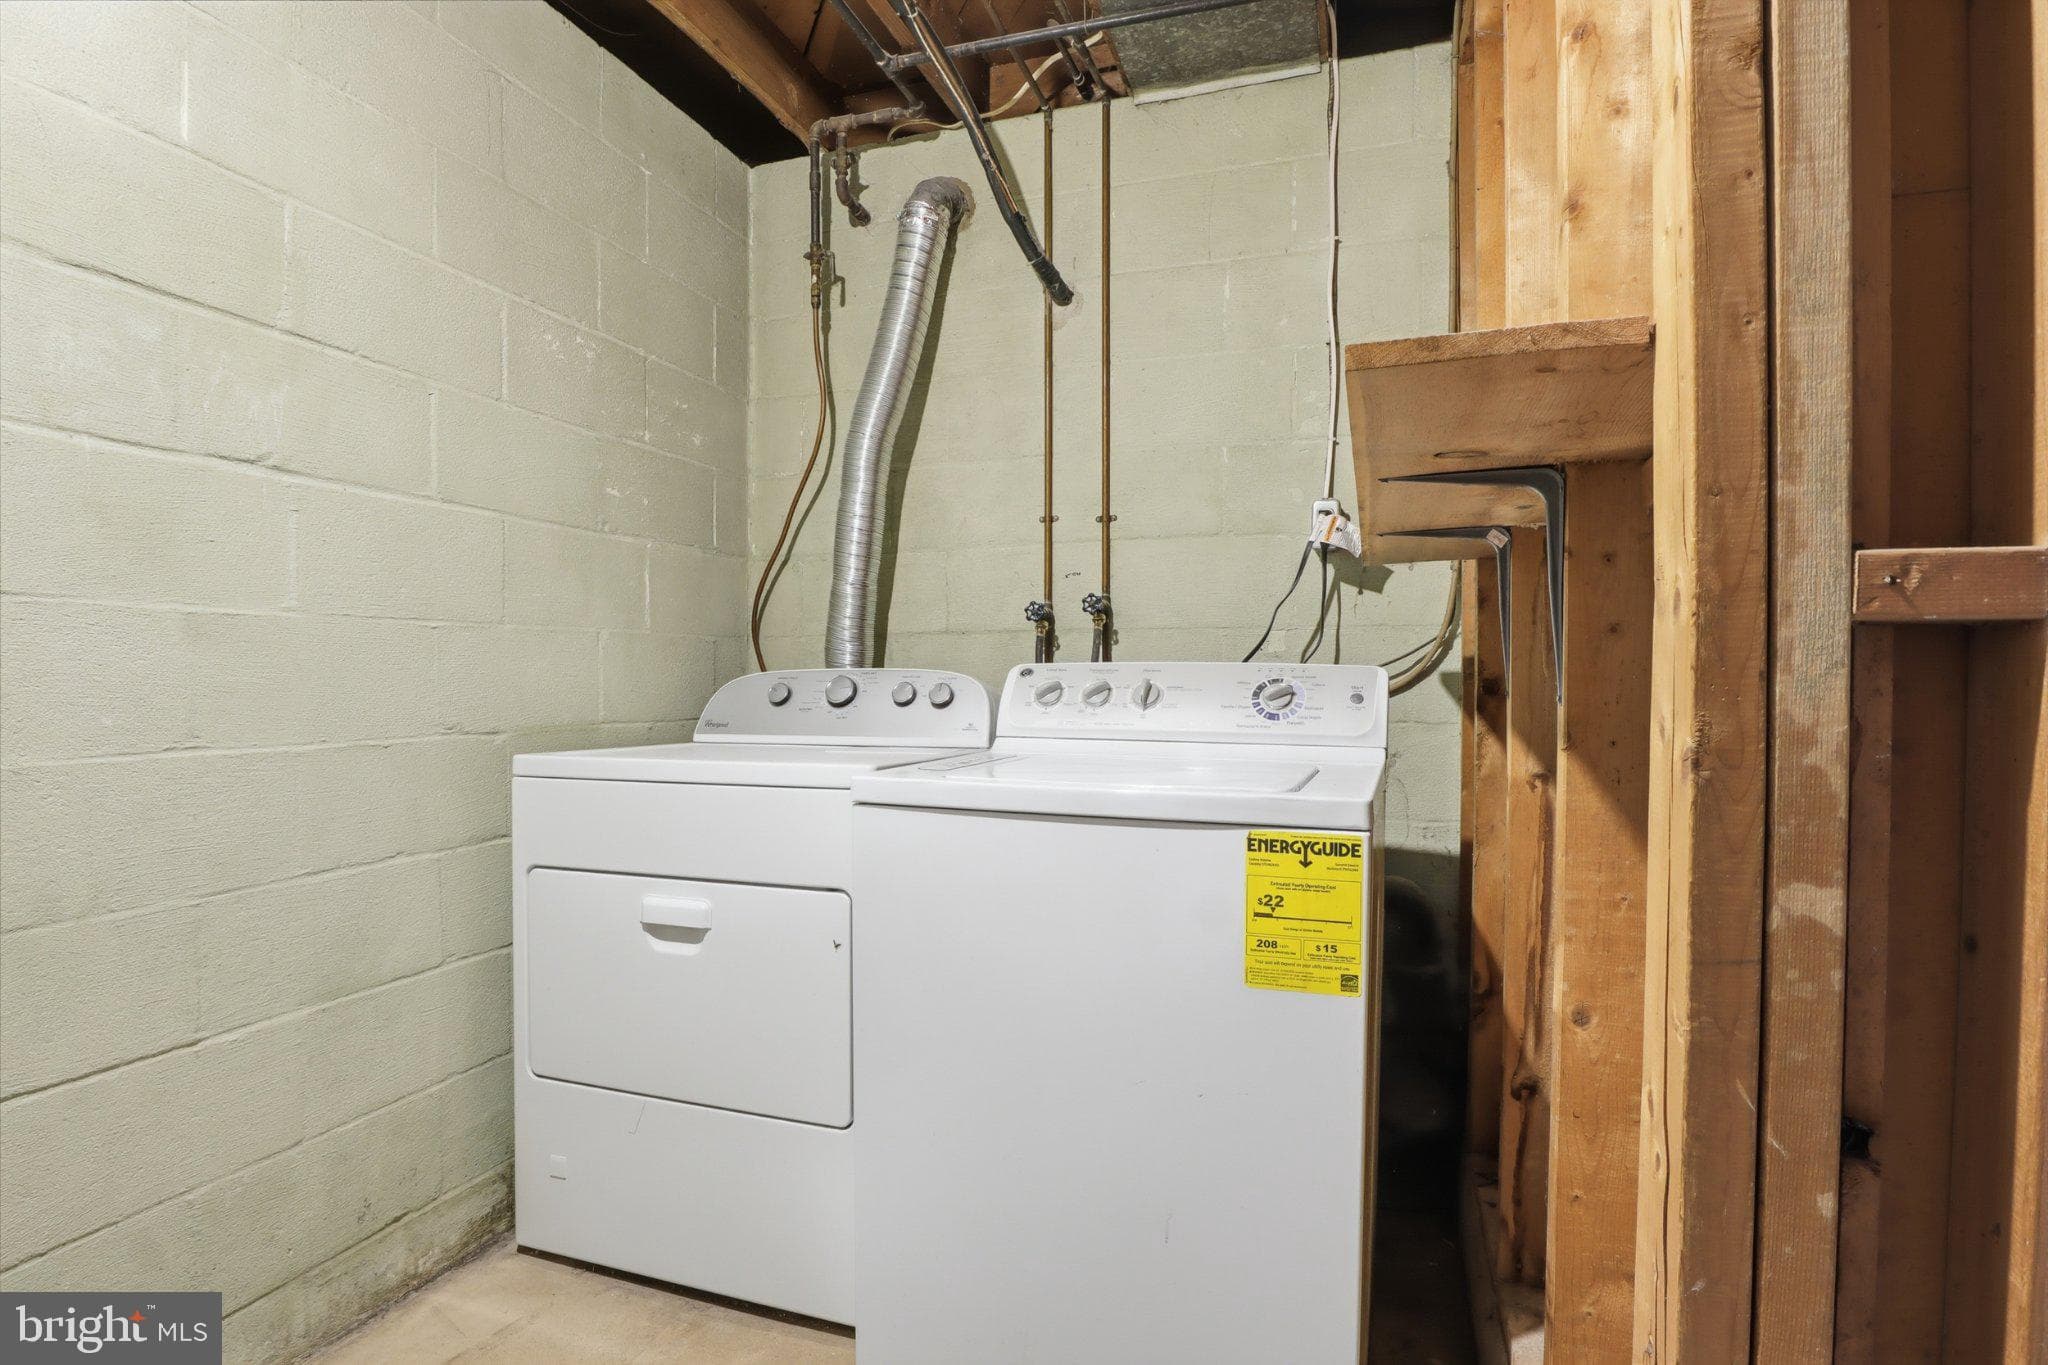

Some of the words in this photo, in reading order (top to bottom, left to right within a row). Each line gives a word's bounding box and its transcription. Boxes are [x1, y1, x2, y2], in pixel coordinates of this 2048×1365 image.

[1247, 837, 1361, 859] ENERGYGUIDE
[1257, 894, 1284, 908] $22
[1256, 939, 1278, 949] 208
